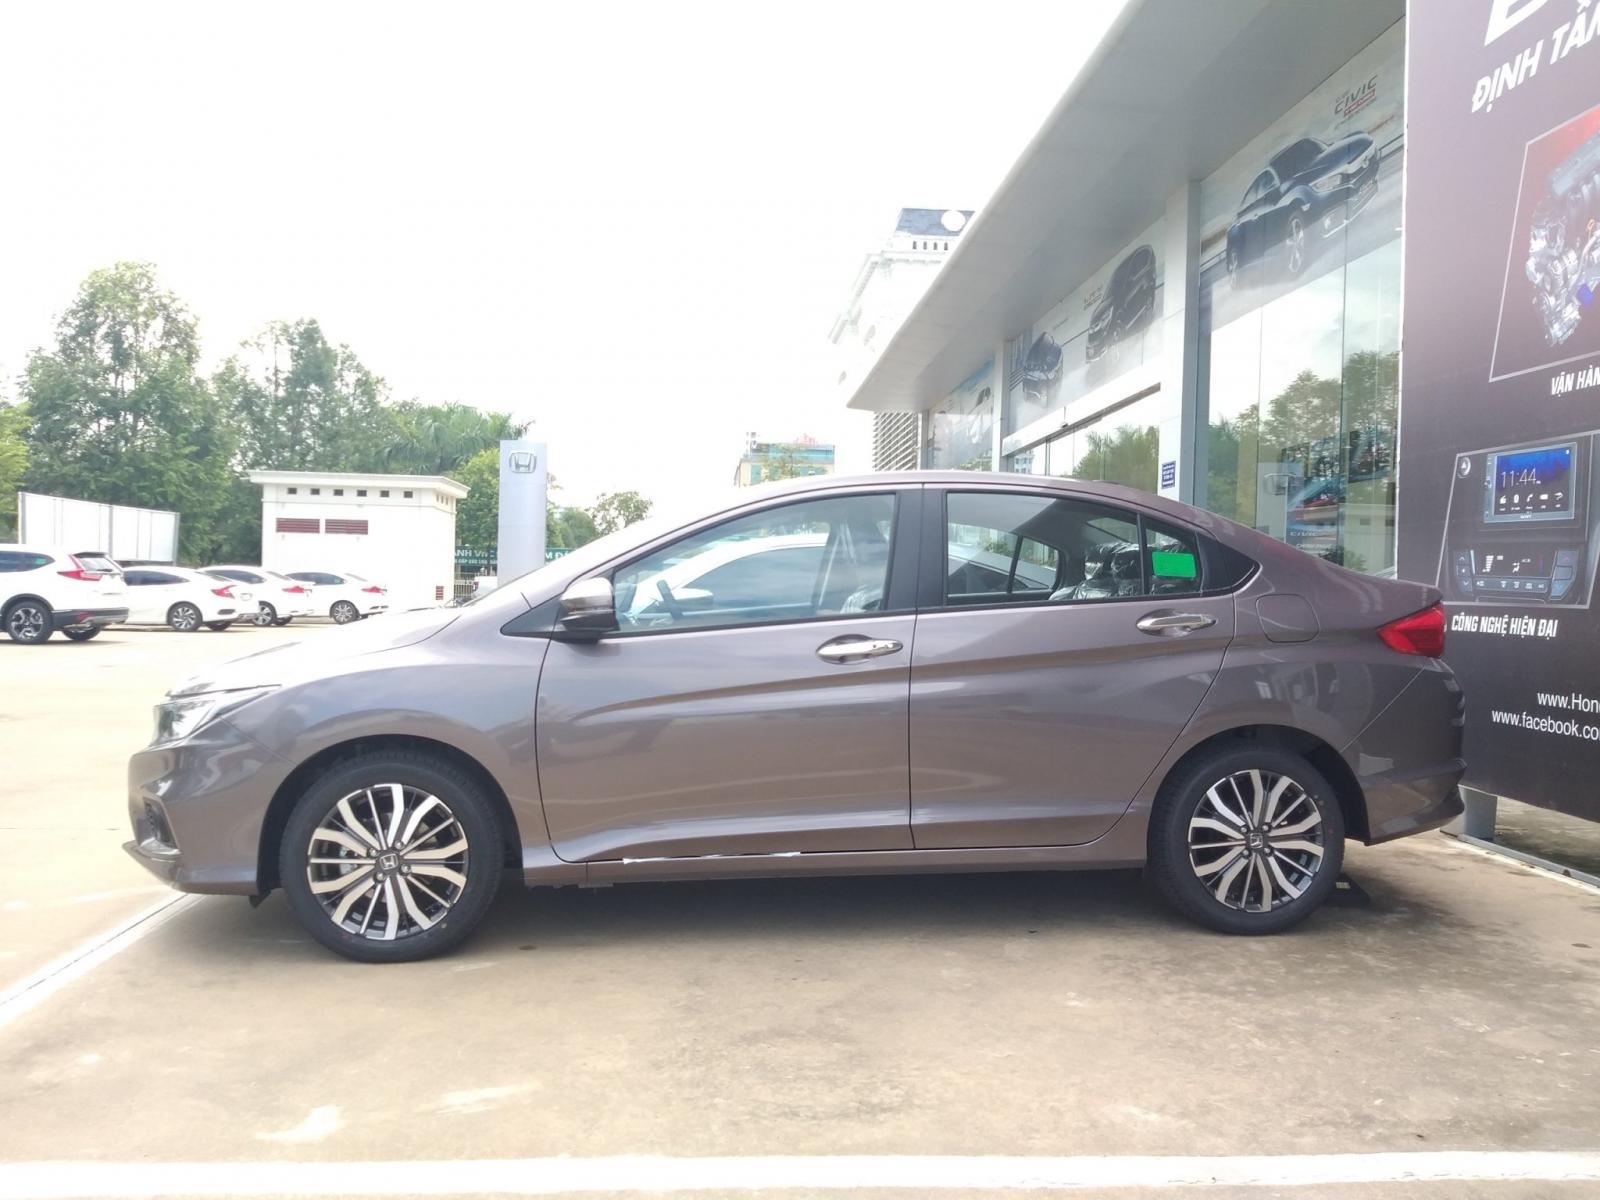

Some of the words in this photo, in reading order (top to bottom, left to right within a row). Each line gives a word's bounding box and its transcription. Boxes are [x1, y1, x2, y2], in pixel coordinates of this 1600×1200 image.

[1472, 39, 1544, 113] ĐỊNH
[1335, 74, 1378, 115] CIVIC
[1552, 371, 1575, 397] VẬN
[1501, 467, 1537, 488] 11:44
[1451, 611, 1479, 632] CÔNG
[1479, 614, 1509, 637] NGHỆ
[1509, 615, 1537, 638] HIỆN
[1537, 619, 1559, 640] ĐẠI
[1537, 692, 1600, 714] www.Hon
[1492, 710, 1600, 741] www.facebook.co
